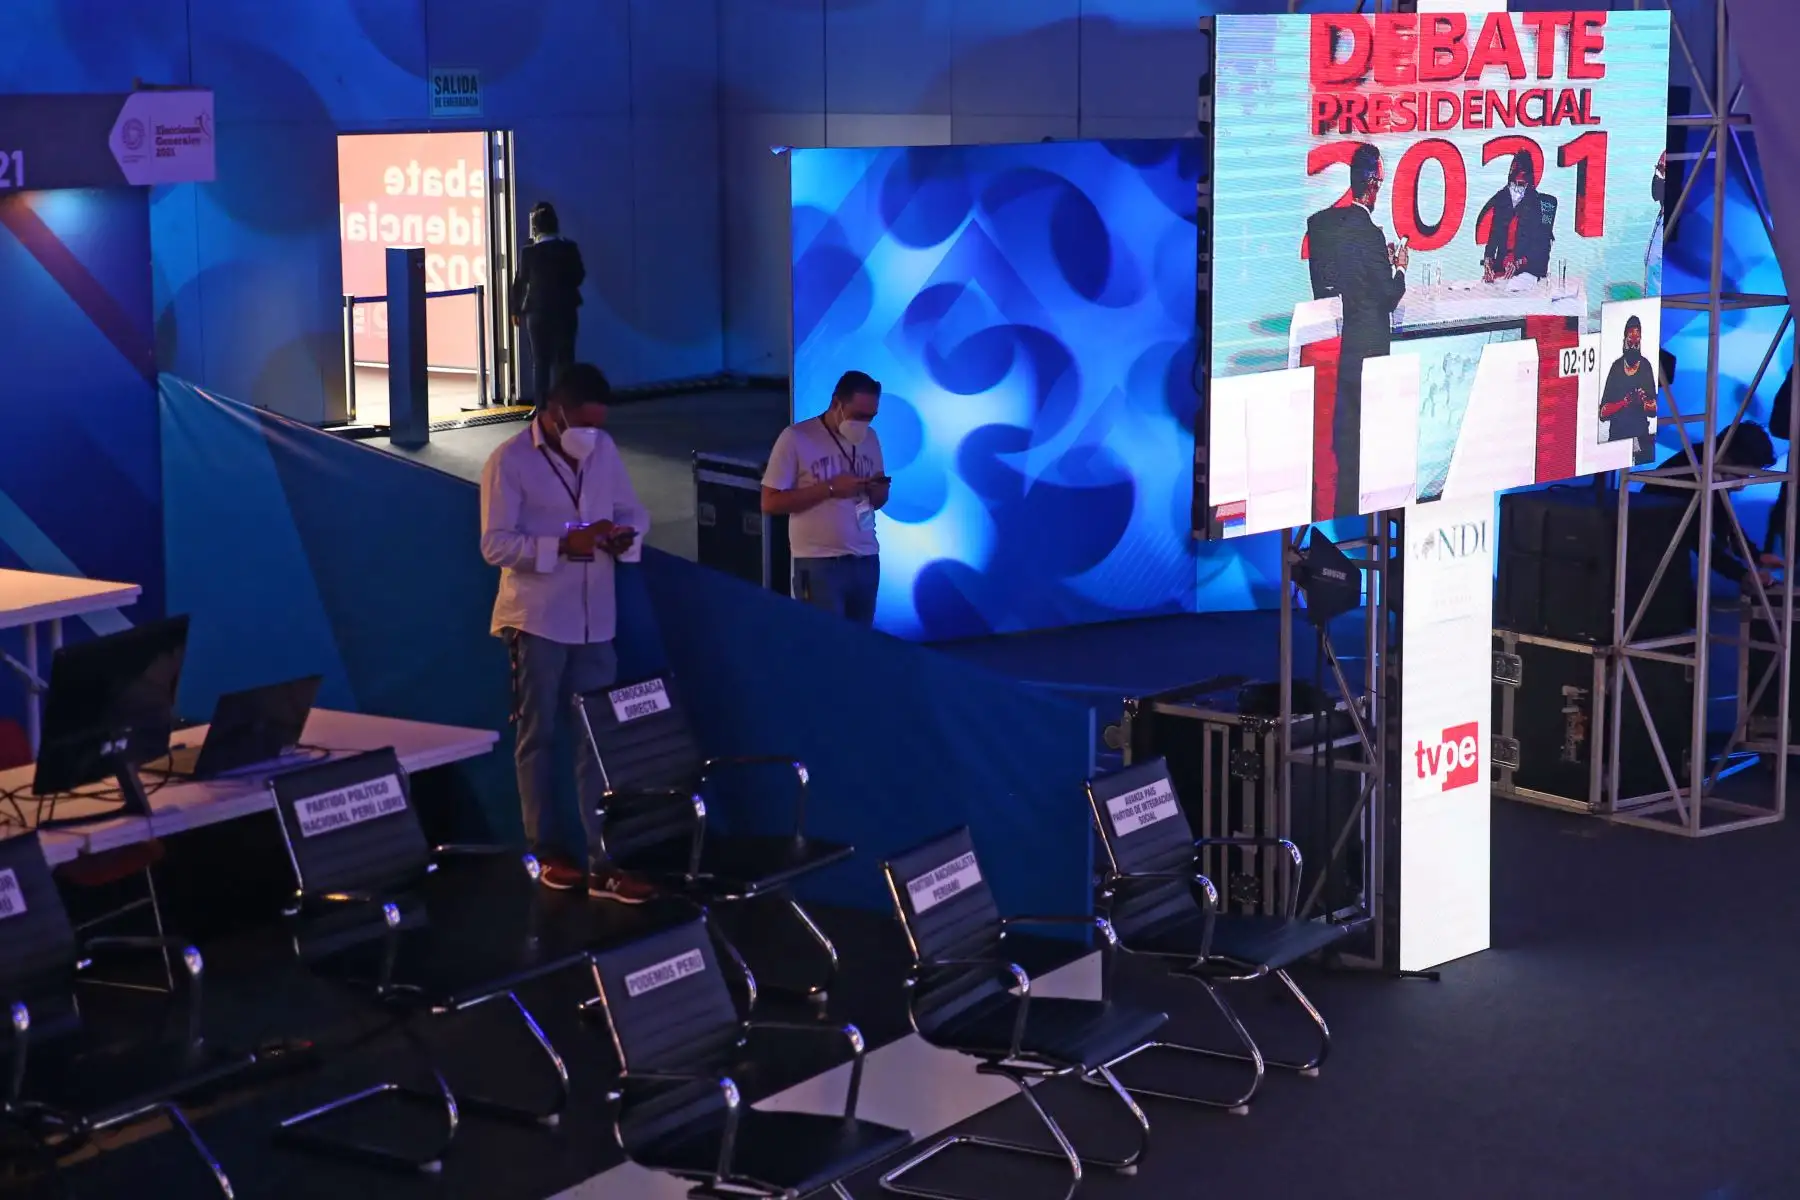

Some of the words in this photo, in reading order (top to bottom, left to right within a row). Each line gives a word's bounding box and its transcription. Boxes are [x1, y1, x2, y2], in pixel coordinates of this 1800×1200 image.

[1309, 11, 1608, 85] DEBATE
[434, 75, 478, 95] SALIDA
[1311, 88, 1601, 135] PRESIDENCIAL
[1563, 347, 1595, 375] 02:19
[611, 680, 664, 704] DEMOCRACIA
[624, 699, 659, 718] DIRECTA
[1414, 735, 1477, 784] tvpe
[305, 793, 347, 815] PARTIDO
[347, 781, 390, 803] POLÍTICO
[1125, 791, 1145, 806] AVANZA
[303, 811, 349, 833] NACIONAL
[377, 796, 405, 813] LIBRE
[1113, 806, 1135, 822] PARTIDO
[1134, 803, 1142, 815] DE
[1138, 811, 1158, 826] SOCIAL
[909, 873, 935, 895] PARTIDO
[934, 854, 975, 882] NACIONALISTA
[932, 877, 961, 901] PERUANO
[628, 964, 677, 993] PODEMOS
